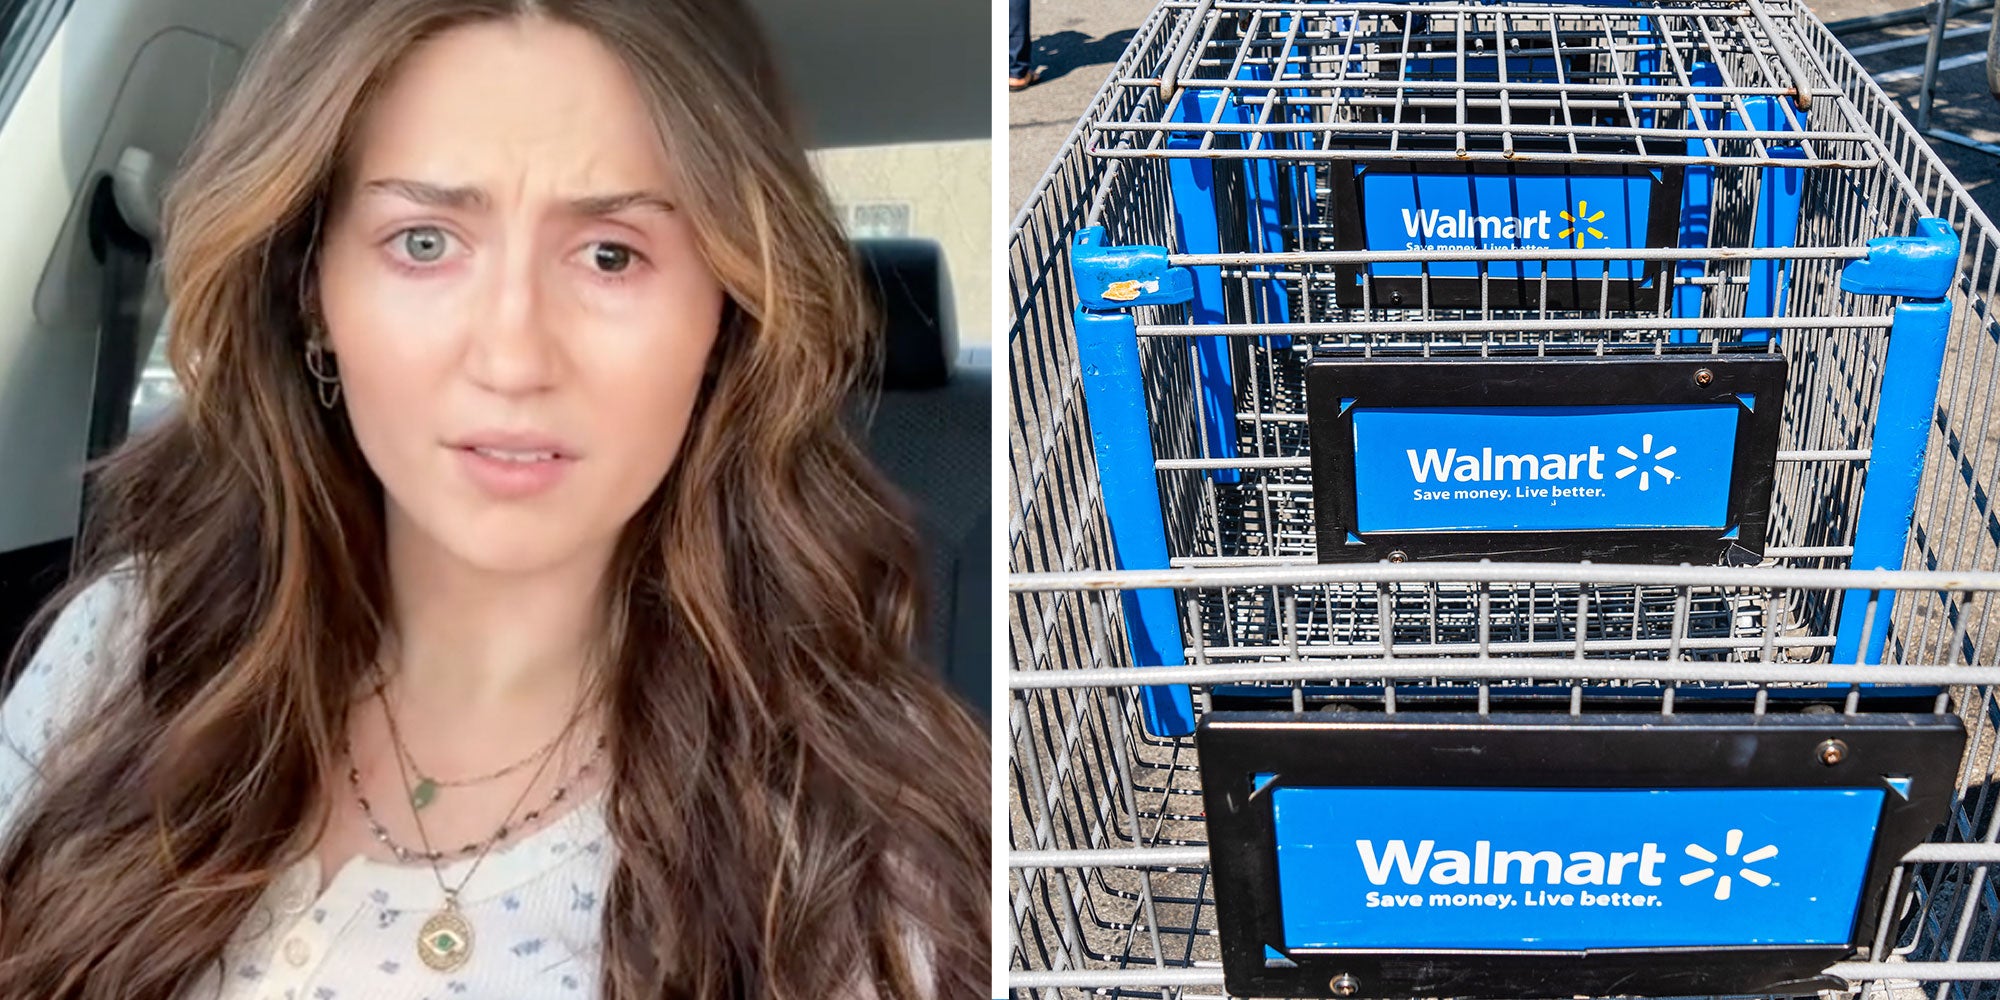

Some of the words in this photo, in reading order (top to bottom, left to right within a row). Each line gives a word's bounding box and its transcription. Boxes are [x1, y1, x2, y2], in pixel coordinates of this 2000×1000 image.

[1402, 209, 1551, 239] Walmart
[1407, 446, 1605, 483] Walmart
[1413, 489, 1450, 501] Save
[1454, 490, 1511, 502] money.
[1516, 486, 1548, 498] Live
[1552, 485, 1606, 498] better.
[1356, 839, 1666, 886] Walmart
[1365, 891, 1424, 908] Save
[1429, 894, 1517, 910] money.
[1525, 891, 1574, 907] Live
[1580, 891, 1663, 907] better.
